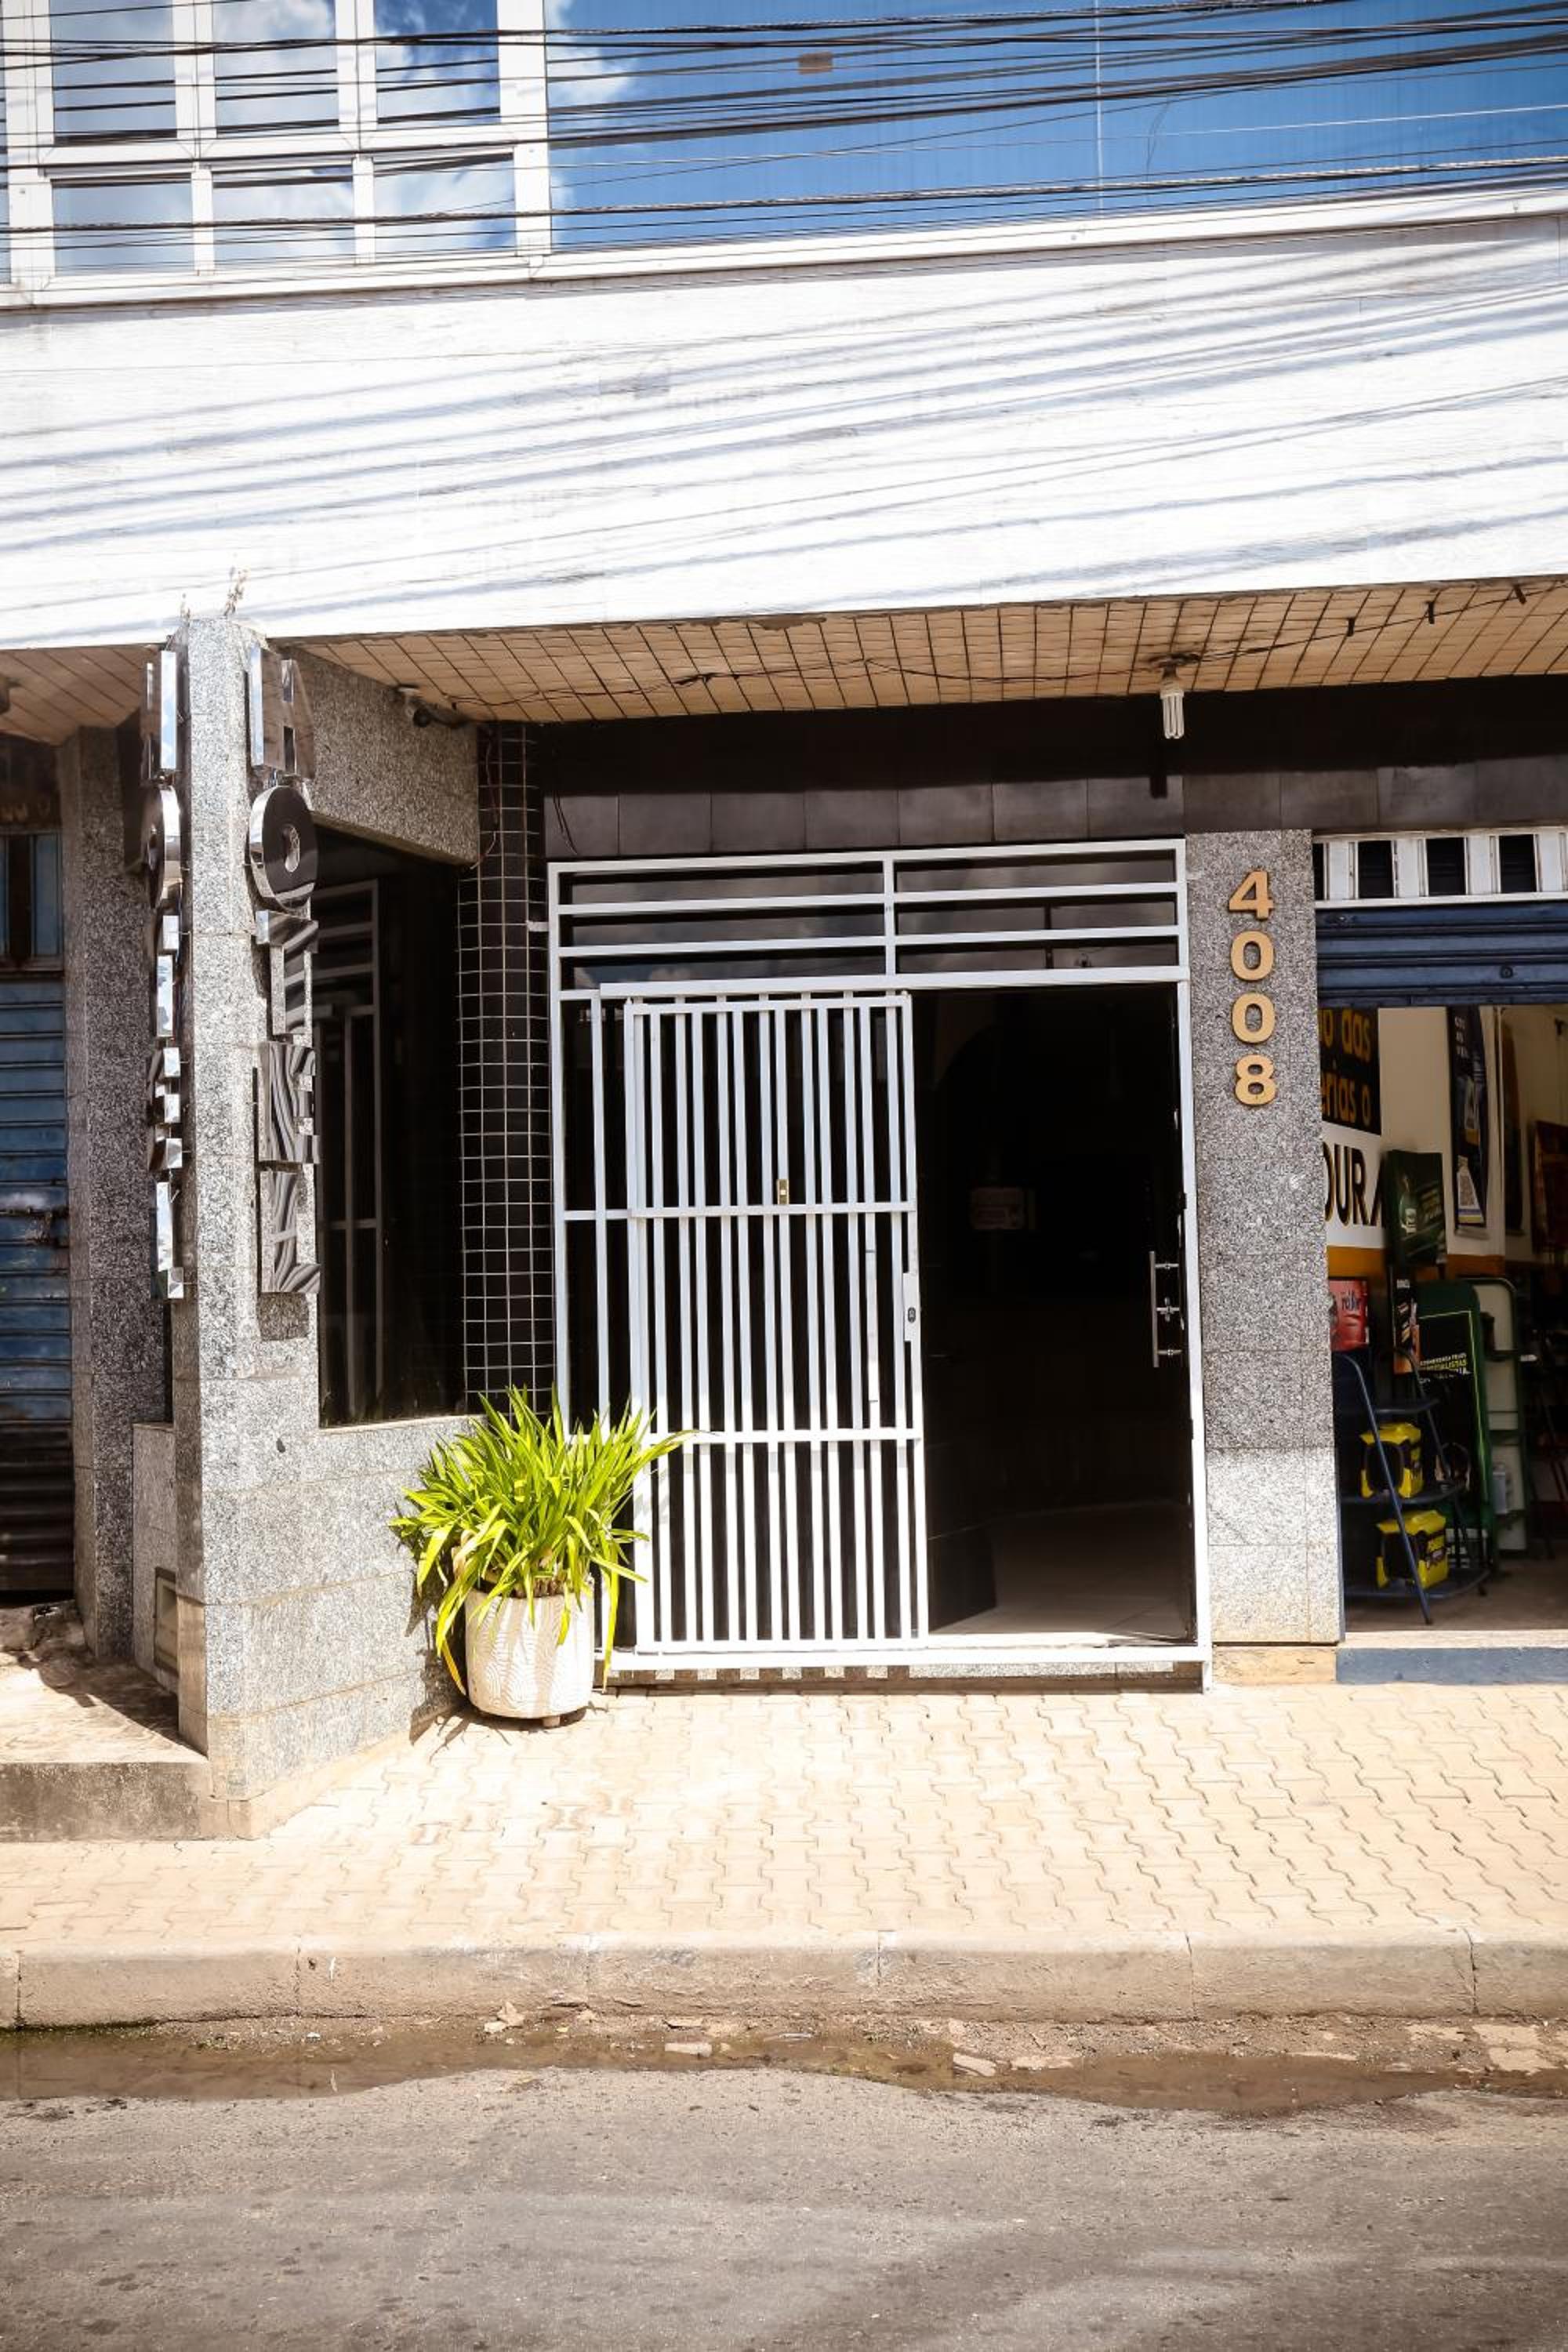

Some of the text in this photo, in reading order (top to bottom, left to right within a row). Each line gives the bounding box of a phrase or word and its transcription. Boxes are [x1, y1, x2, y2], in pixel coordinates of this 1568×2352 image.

[250, 647, 321, 1294] HOTEL
[1228, 870, 1276, 1106] 4008
[1318, 1008, 1334, 1048] o
